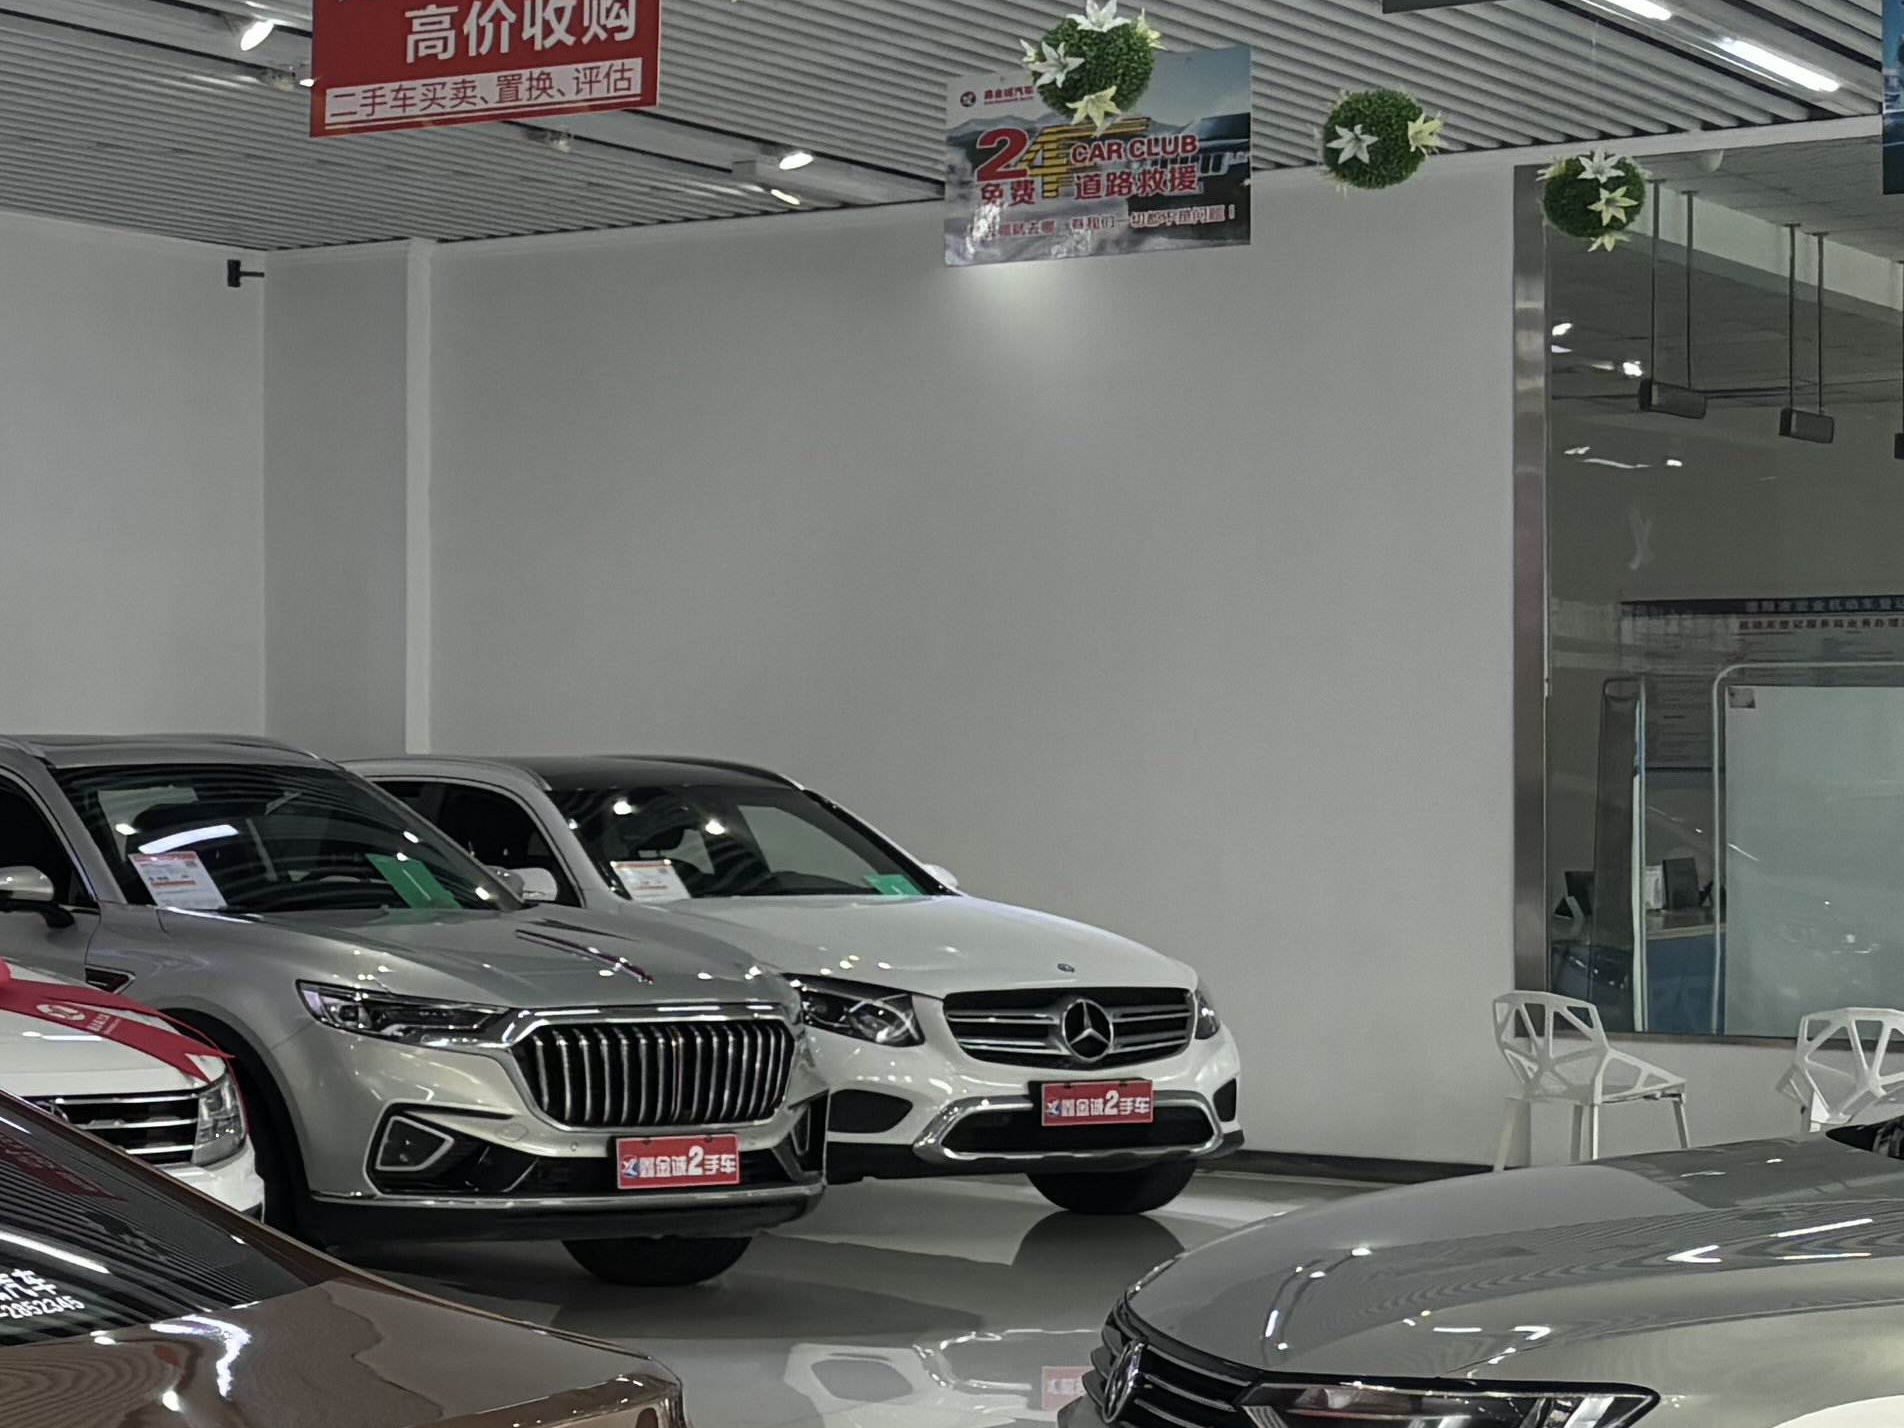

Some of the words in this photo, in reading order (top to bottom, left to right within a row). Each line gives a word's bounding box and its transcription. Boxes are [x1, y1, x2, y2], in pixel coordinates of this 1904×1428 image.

[329, 62, 635, 119] 二手车买卖、置换、评估
[1074, 165, 1200, 201] 道路救援
